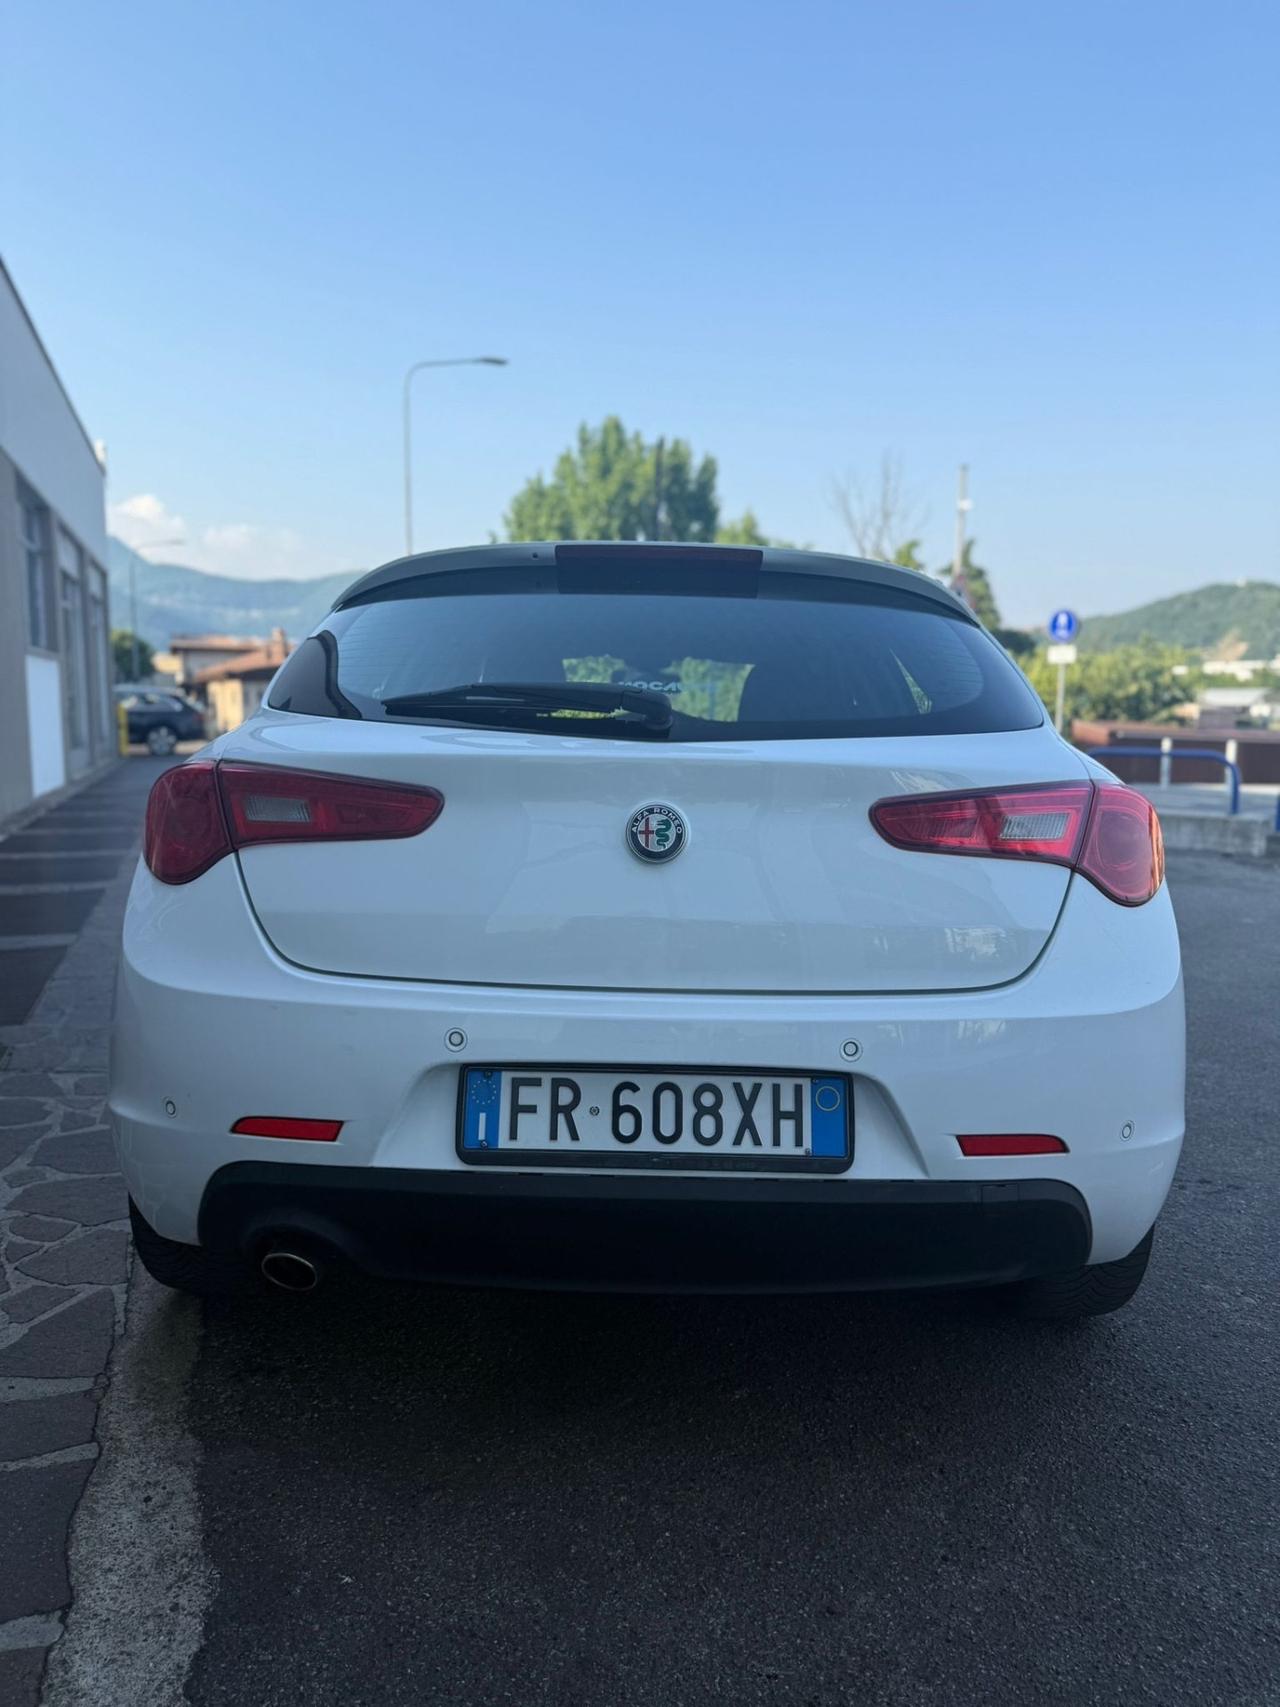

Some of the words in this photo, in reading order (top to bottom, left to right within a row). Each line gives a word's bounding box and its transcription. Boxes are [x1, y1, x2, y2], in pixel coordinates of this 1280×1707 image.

[631, 810, 650, 833] ALFA
[653, 807, 683, 834] ROMEO
[508, 1076, 582, 1142] FR
[611, 1080, 804, 1147] 608XH
